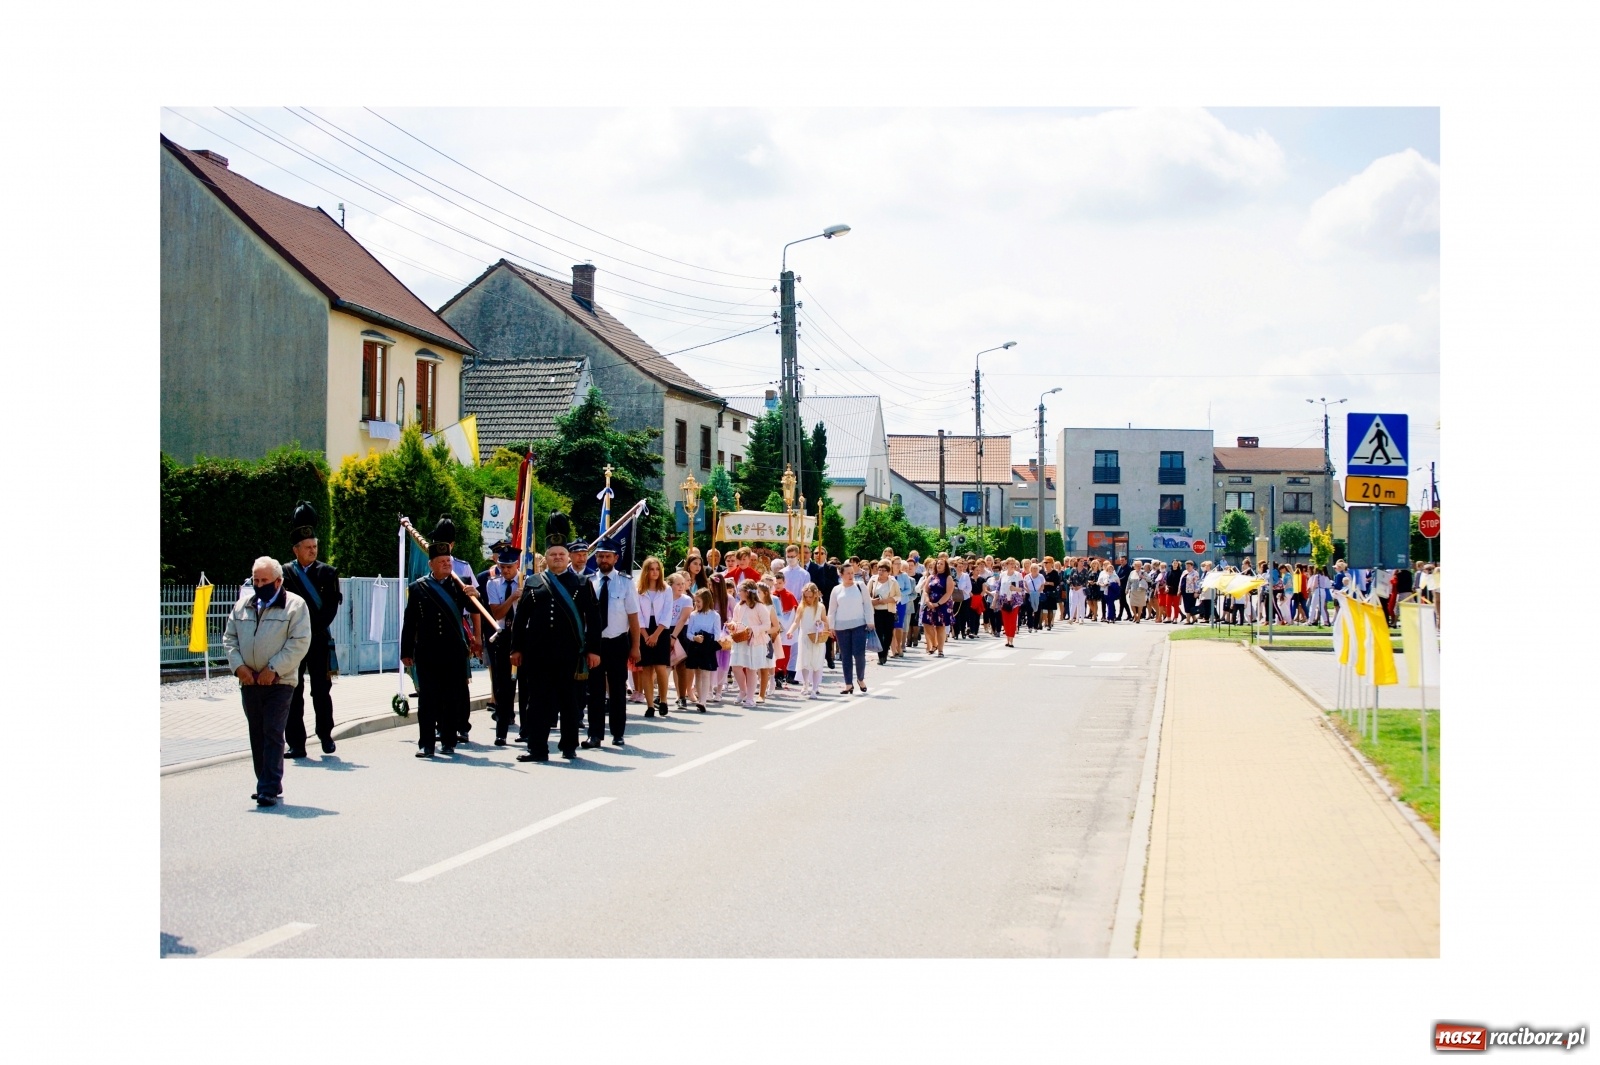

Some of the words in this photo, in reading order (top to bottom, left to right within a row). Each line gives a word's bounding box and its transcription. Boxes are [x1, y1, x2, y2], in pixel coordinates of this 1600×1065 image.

[1362, 482, 1381, 499] 20
[1384, 489, 1395, 498] m
[1421, 519, 1440, 529] STOP
